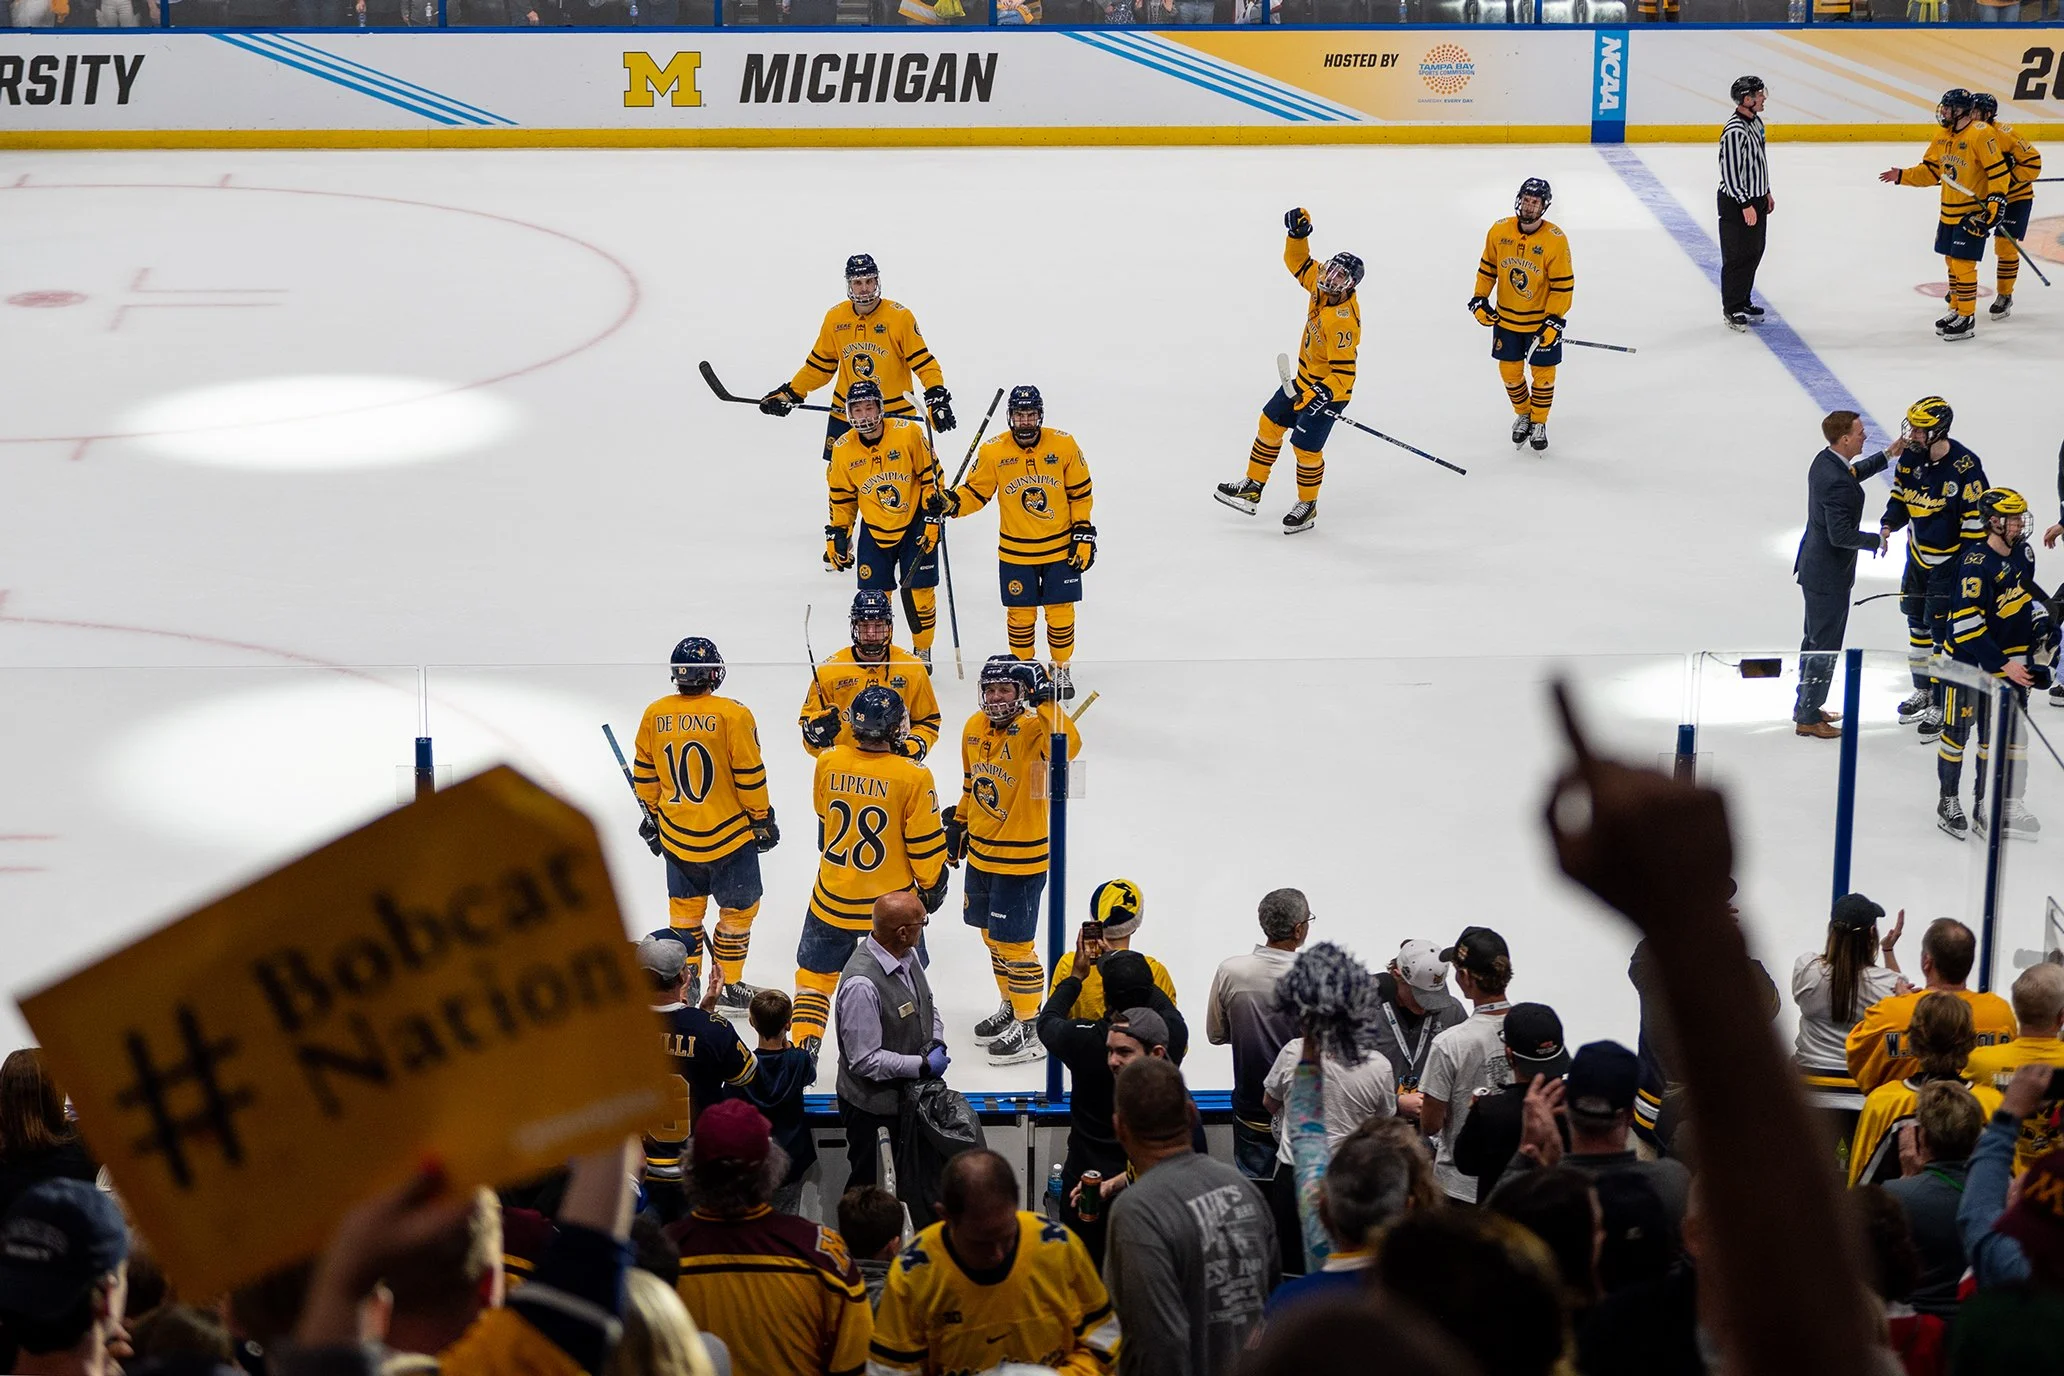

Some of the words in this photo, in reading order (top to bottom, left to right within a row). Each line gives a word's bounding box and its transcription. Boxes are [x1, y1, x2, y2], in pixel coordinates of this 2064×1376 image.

[1324, 54, 1377, 68] HOSTED
[1380, 54, 1399, 68] BY
[1418, 63, 1453, 71] TAMPA
[1599, 35, 1622, 110] NCAA
[623, 51, 702, 107] M
[739, 52, 999, 104] MICHIGAN
[1336, 331, 1353, 349] 29
[860, 471, 912, 495] QUINNIPIAC
[1004, 474, 1063, 496] QUINNIPIAC
[1962, 480, 1983, 504] 43
[1961, 576, 1983, 599] 13
[678, 666, 687, 675] 10
[656, 715, 673, 733] DE
[678, 714, 716, 735] JONG
[855, 712, 866, 722] 28
[1000, 741, 1013, 760] A
[663, 739, 715, 804] 10
[829, 772, 890, 798] LIPKIN
[823, 798, 890, 873] 28
[252, 845, 590, 1034] Bobcat
[296, 942, 632, 1120] Nation
